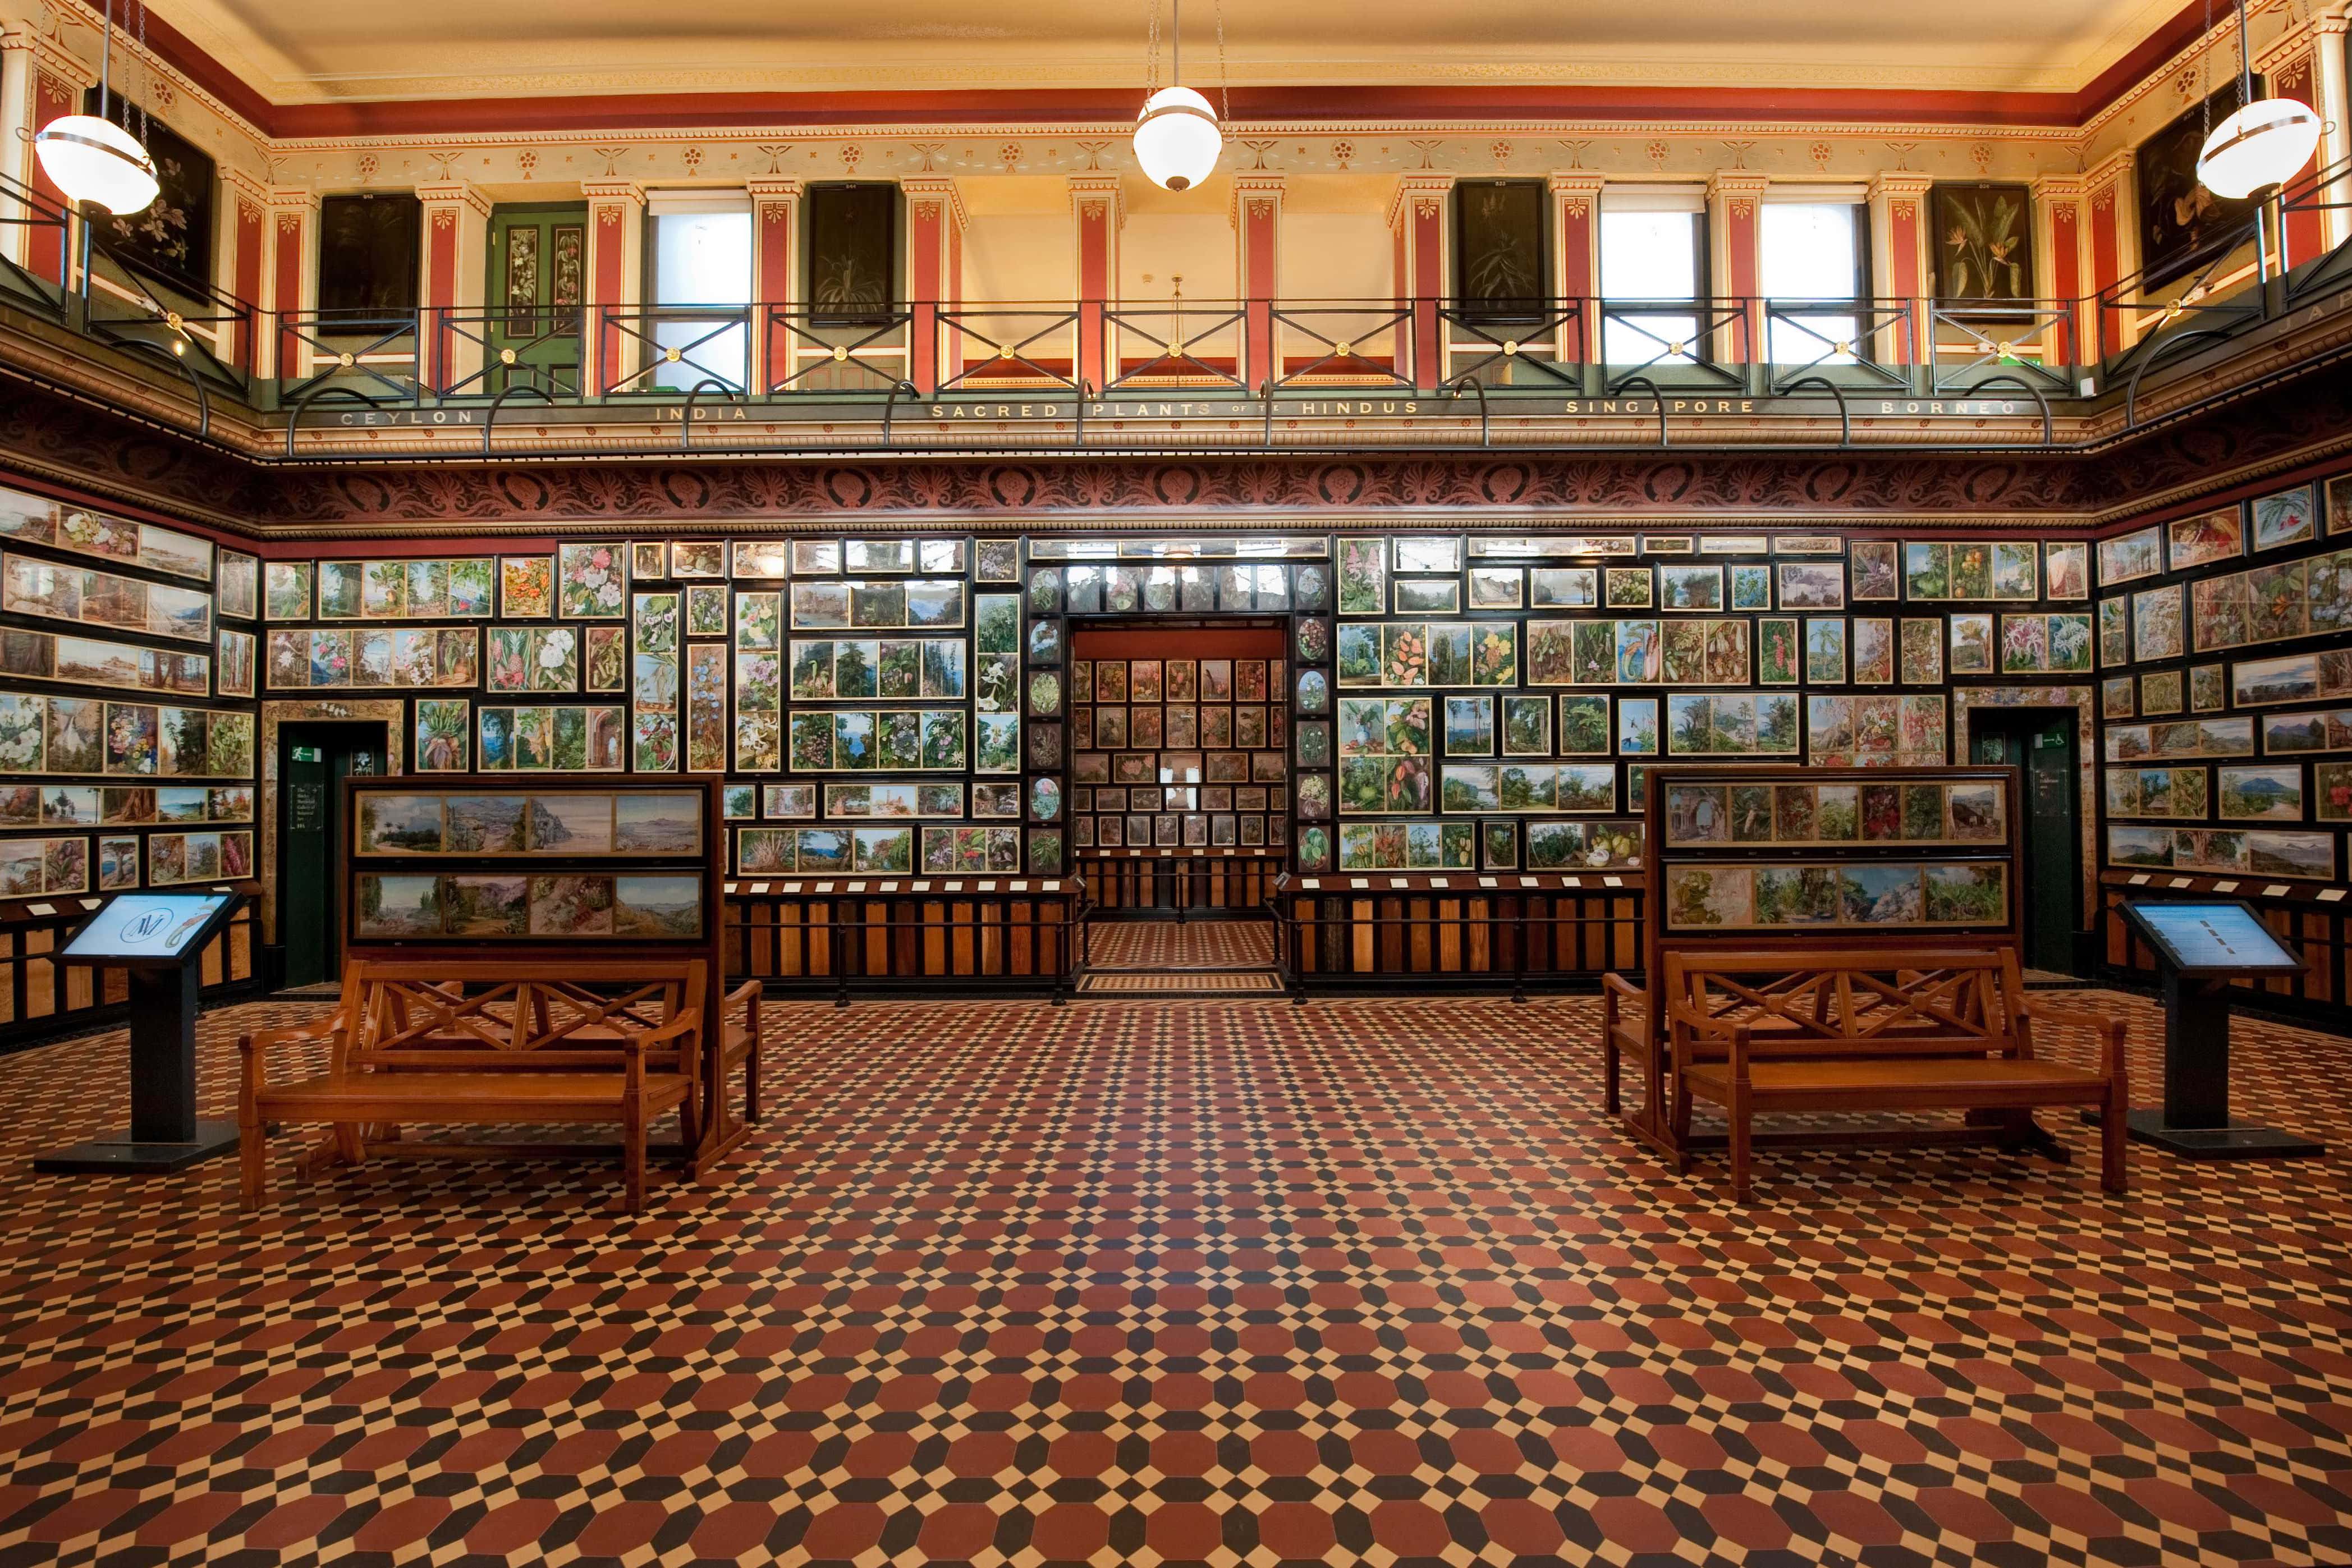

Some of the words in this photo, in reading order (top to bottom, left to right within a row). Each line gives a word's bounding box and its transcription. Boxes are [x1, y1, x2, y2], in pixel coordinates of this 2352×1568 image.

[656, 407, 746, 420] INDIA
[932, 405, 1057, 417] SACRED
[1093, 404, 1211, 416] PLANTS
[1303, 402, 1417, 414] HINDUS
[1881, 401, 2014, 414] BORNEO
[341, 411, 471, 425] CEYLON
